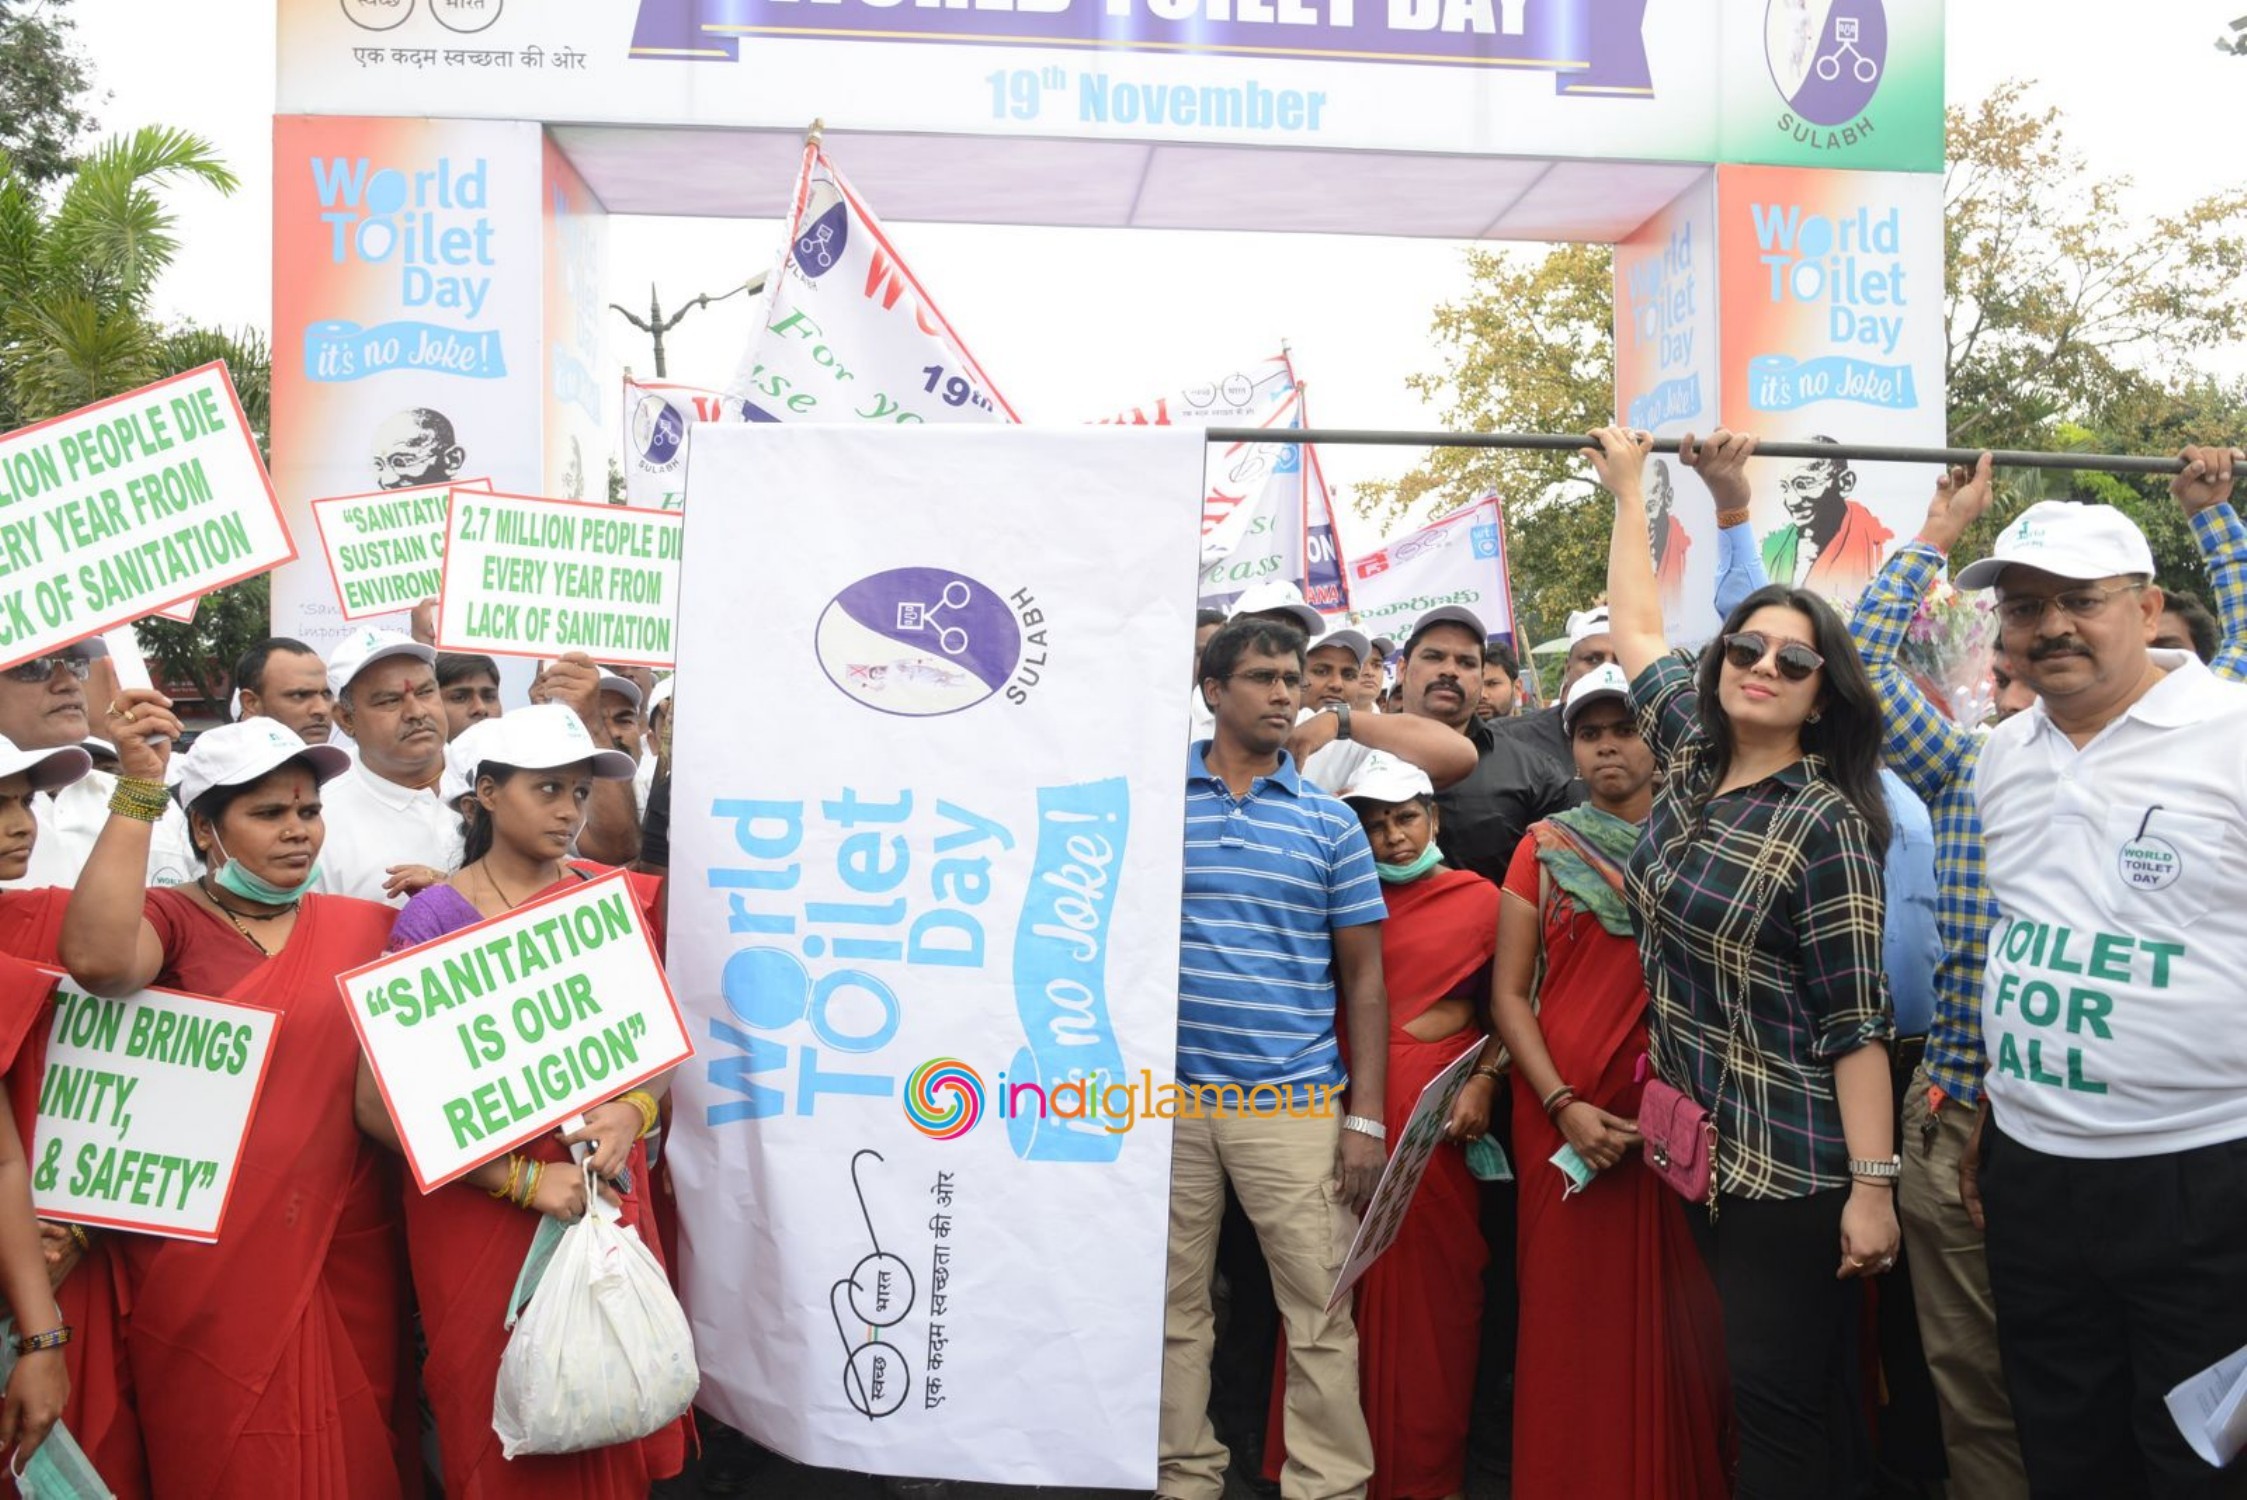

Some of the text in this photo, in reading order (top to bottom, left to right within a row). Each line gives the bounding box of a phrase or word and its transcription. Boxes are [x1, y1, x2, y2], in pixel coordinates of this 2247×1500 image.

[352, 46, 587, 71] एक कदम स्वच्छता की ओर
[986, 64, 1327, 130] 19th November
[1776, 112, 1875, 150] SULABH
[310, 156, 486, 215] World
[1751, 203, 1899, 257] World
[402, 266, 491, 320] Day
[318, 330, 488, 376] it's no Joke!
[768, 308, 854, 383] For
[1661, 327, 1694, 370] Day
[1830, 305, 1903, 356] Day
[1760, 363, 1902, 406] it's no Joke!
[59, 405, 174, 482] PEOPLE
[170, 387, 225, 443] DIE
[43, 488, 131, 553] YEAR
[126, 458, 214, 526] FROM
[460, 505, 490, 542] 2.7
[495, 512, 575, 551] MILLION
[581, 518, 653, 558] PEOPLE
[35, 574, 74, 629] OF
[79, 511, 252, 613] SANITATION
[339, 534, 427, 573] SUSTAIN
[482, 555, 662, 605] EVERY YEAR FROM
[466, 601, 671, 653] LACK OF SANITATION
[1006, 586, 1051, 705] SULABH
[906, 797, 1015, 968] Day
[1032, 810, 1118, 962] Joke!
[2124, 848, 2173, 862] WORLD
[2125, 860, 2174, 873] TOILET
[2133, 873, 2160, 885] DAY
[366, 893, 632, 1027] “SANITATION
[707, 798, 811, 1127] World
[457, 973, 603, 1070] IS OUR
[1045, 978, 1101, 1045] no
[1995, 973, 2114, 1040] FOR
[125, 1006, 252, 1076] BRINGS
[1998, 1032, 2108, 1095] ALL
[442, 1012, 646, 1150] RELIGION”
[34, 1138, 219, 1211] & SAFETY”
[925, 1170, 954, 1409] एक कदम स्वच्छता की ओर
[871, 1269, 892, 1401] स्वच्छ भारत
